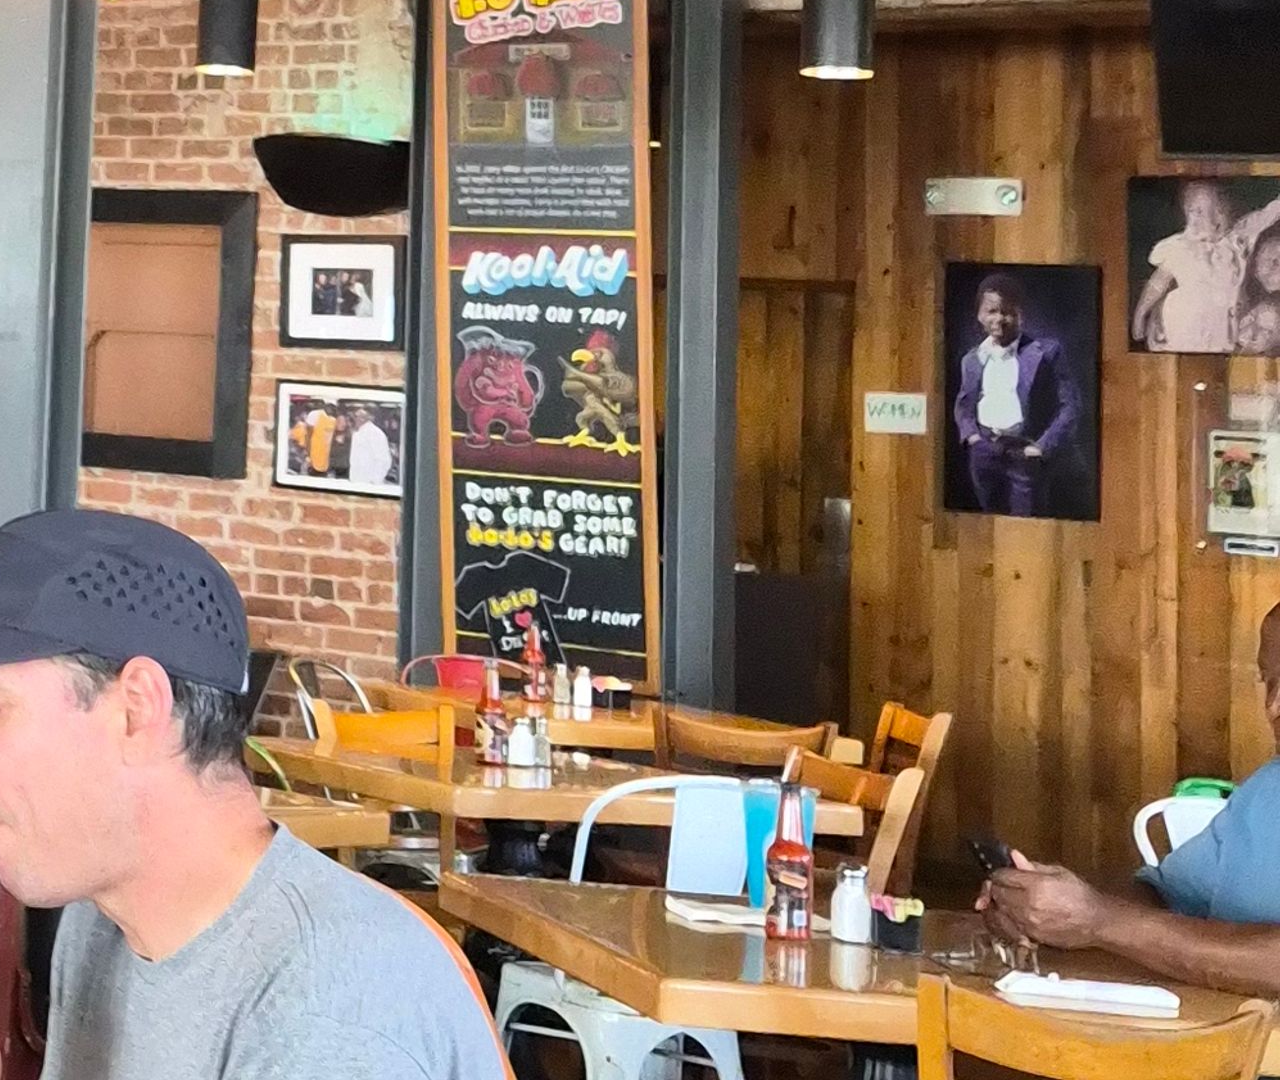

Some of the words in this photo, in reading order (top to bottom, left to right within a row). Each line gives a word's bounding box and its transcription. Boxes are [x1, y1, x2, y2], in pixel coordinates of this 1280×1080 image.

[461, 301, 541, 323] ALWAYS
[545, 306, 573, 324] ON
[578, 307, 628, 332] TAP!
[465, 481, 533, 506] DON'T
[543, 489, 634, 516] FORGET
[460, 503, 495, 526] TO
[502, 505, 564, 531] GRAB
[573, 514, 638, 539] SOME
[591, 608, 643, 628] FRONT
